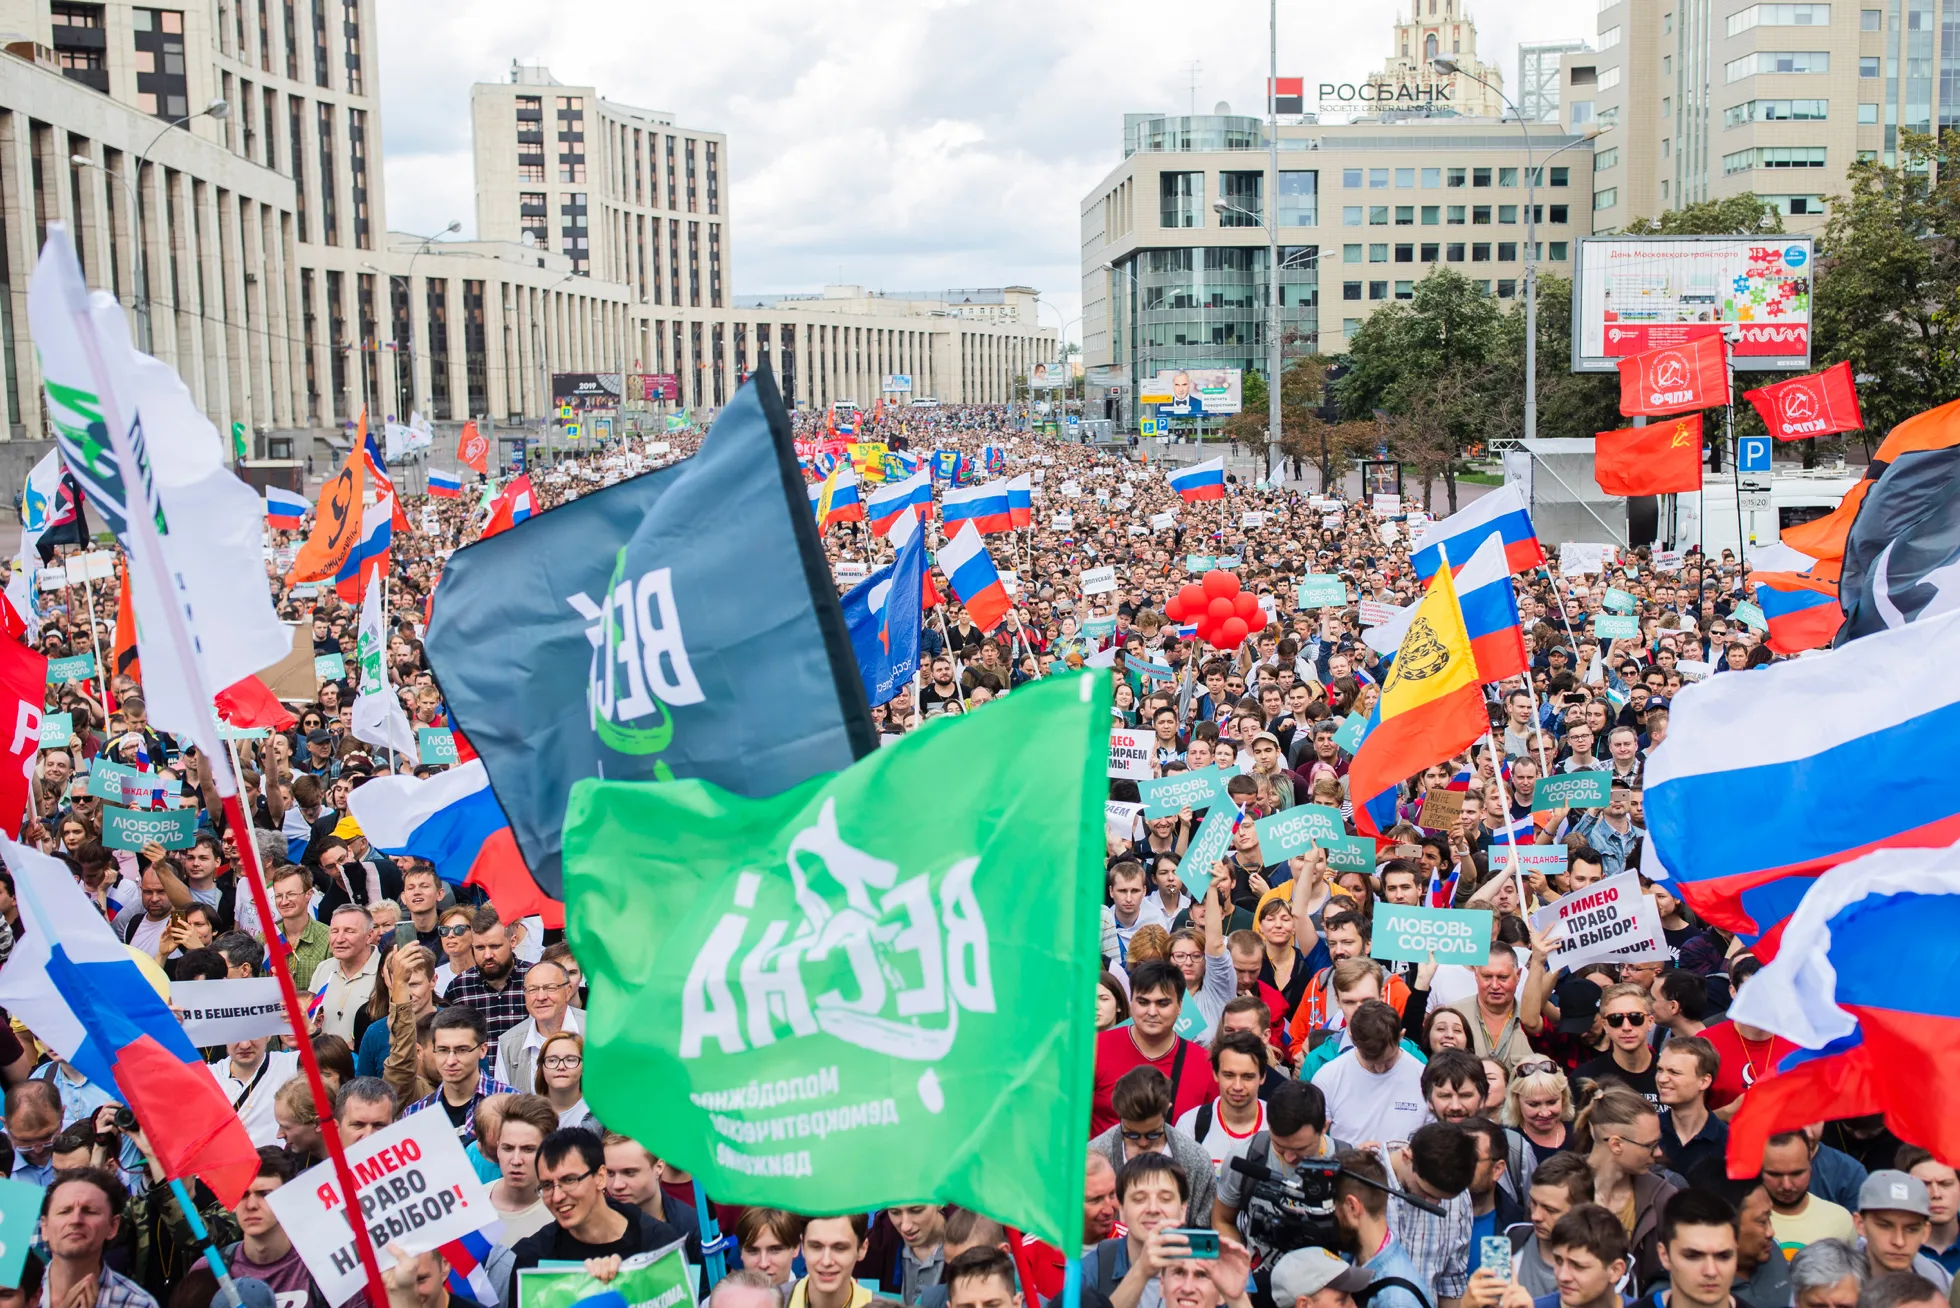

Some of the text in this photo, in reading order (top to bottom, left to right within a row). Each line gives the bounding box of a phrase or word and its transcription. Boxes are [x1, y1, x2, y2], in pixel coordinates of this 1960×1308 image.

[1319, 83, 1450, 101] РОСБАНК
[1610, 250, 1738, 261] День Московского транспорта
[1752, 248, 1763, 257] 13
[579, 382, 597, 390] 2019
[1747, 441, 1765, 468] P
[1756, 498, 1766, 506] 20
[1304, 588, 1338, 597] ЛЮБОВЬ
[1309, 595, 1341, 603] СОБОЛЬ
[1600, 619, 1633, 628] ЛЮБОВЬ
[1605, 626, 1634, 634] СОБОЛЬ
[54, 666, 90, 679] СОБОЛЬ
[427, 735, 454, 746] ЛЮБ
[1109, 735, 1135, 747] ДЕСЬ
[1109, 758, 1130, 770] МЫ!
[1150, 777, 1209, 799] ЛЮБОВЬ
[1541, 779, 1599, 795] ЛЮБОВЬ
[1161, 788, 1215, 808] СОБОЛЬ
[1548, 789, 1602, 802] СОБОЛЬ
[112, 817, 181, 833] ЛЮБОВЬ
[1268, 813, 1333, 840] ЛЮБОВЬ
[121, 831, 184, 844] СОБОЛЬ
[1187, 811, 1224, 877] ЛЮБОВЬ
[1200, 816, 1233, 875] СОБОЛЬ
[1281, 827, 1339, 849] СОБОЛЬ
[1523, 855, 1559, 865] ЖДАНОВ
[1559, 887, 1619, 919] Я ИМЕЮ
[1386, 916, 1473, 937] ЛЮБОВЬ
[1566, 905, 1618, 934] ПРАВО
[1579, 916, 1638, 949] ВЫБОР!
[1398, 934, 1477, 953] СОБОЛЬ
[183, 1010, 192, 1020] Я
[194, 1009, 203, 1020] В
[316, 1182, 340, 1212] Я
[368, 1183, 469, 1249] ВЫБОР!
